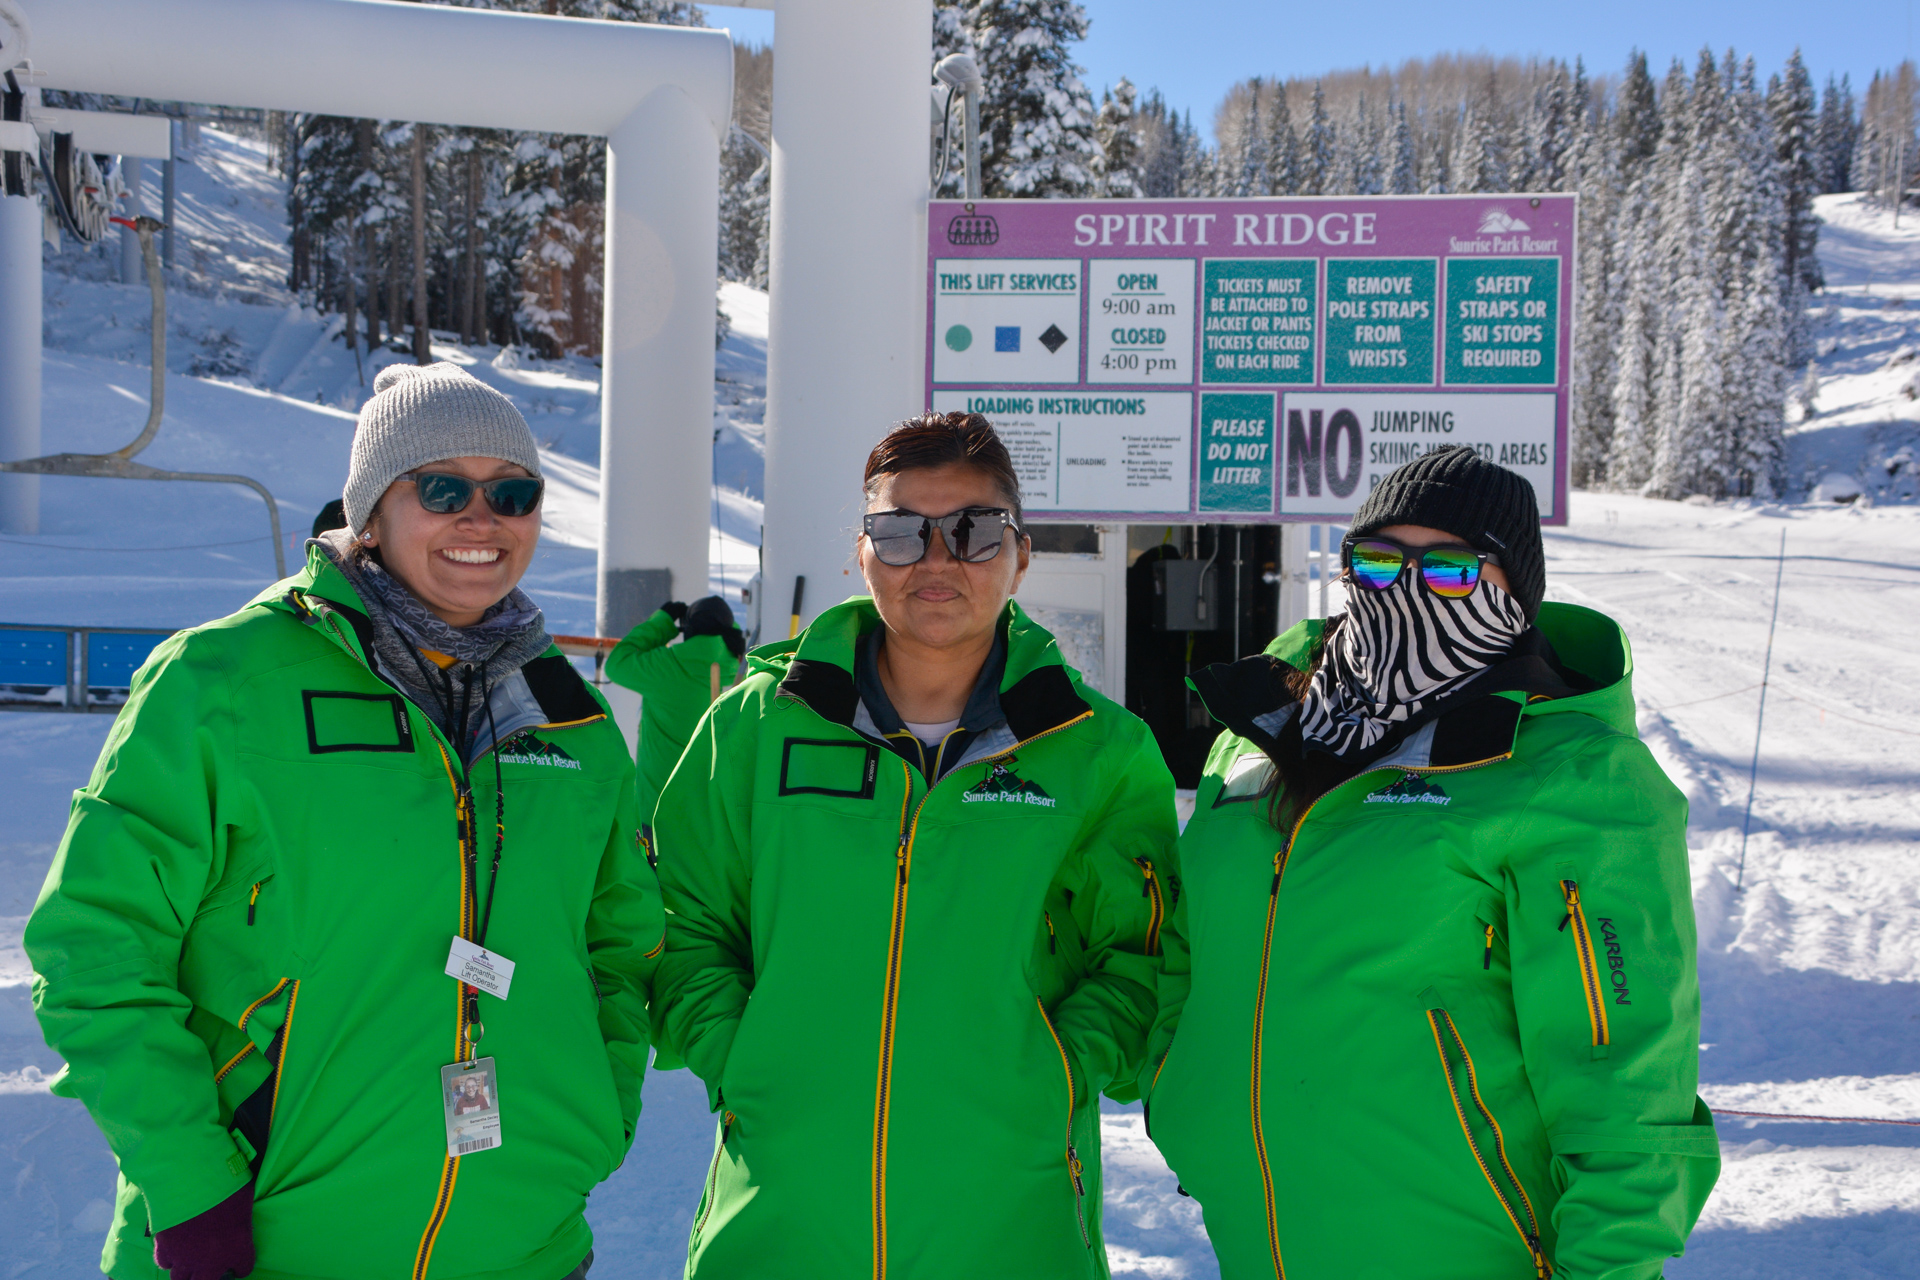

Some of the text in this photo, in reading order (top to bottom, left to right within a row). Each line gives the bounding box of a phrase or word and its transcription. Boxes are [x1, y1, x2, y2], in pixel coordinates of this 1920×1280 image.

[1074, 213, 1377, 246] SPIRIT RIDGE
[1449, 236, 1558, 253] Sunrise Park Resort
[940, 273, 1077, 291] THIS LIFT SERVICES
[1117, 273, 1158, 291] OPEN
[1218, 278, 1302, 293] TICKETS MUST
[1347, 277, 1413, 295] REMOVE
[1475, 276, 1533, 294] SAFETY
[1102, 299, 1176, 315] 9:00 am
[1211, 298, 1308, 312] BE ATTACHED TO
[1329, 301, 1430, 319] POLE STRAPS
[1459, 301, 1547, 319] STRAPS OR
[1205, 316, 1312, 332] JACKET OR PANTS
[1111, 328, 1167, 345] CLOSED
[1207, 335, 1310, 350] TICKETS CHECKED
[1355, 325, 1401, 343] FROM
[1463, 325, 1543, 343] SKI STOPS
[1100, 354, 1177, 375] 4:00 pm
[1215, 354, 1300, 369] ON EACH RIDE
[1349, 349, 1407, 367] WRISTS
[1462, 349, 1542, 367] REQUIRED
[967, 397, 1146, 415] LOADING INSTRUCTIONS
[1211, 419, 1266, 438] PLEASE
[1370, 410, 1455, 434] JUMPING
[1207, 443, 1269, 461] DO NOT
[1285, 408, 1364, 499] NO
[1370, 442, 1421, 465] SKIING
[1499, 443, 1548, 465] AREAS
[1066, 458, 1107, 466] UNLOADING
[1212, 466, 1262, 485] LITTER
[399, 711, 409, 734] KARBON
[529, 753, 552, 766] Park
[552, 753, 582, 770] Resort
[868, 759, 876, 782] KARBON
[962, 791, 1056, 808] Sunrise Park Resort
[1363, 792, 1451, 805] Sunrise Park Resort
[1597, 917, 1632, 1006] KARBON
[461, 969, 499, 991] Lift Operator
[465, 962, 496, 981] Samantha
